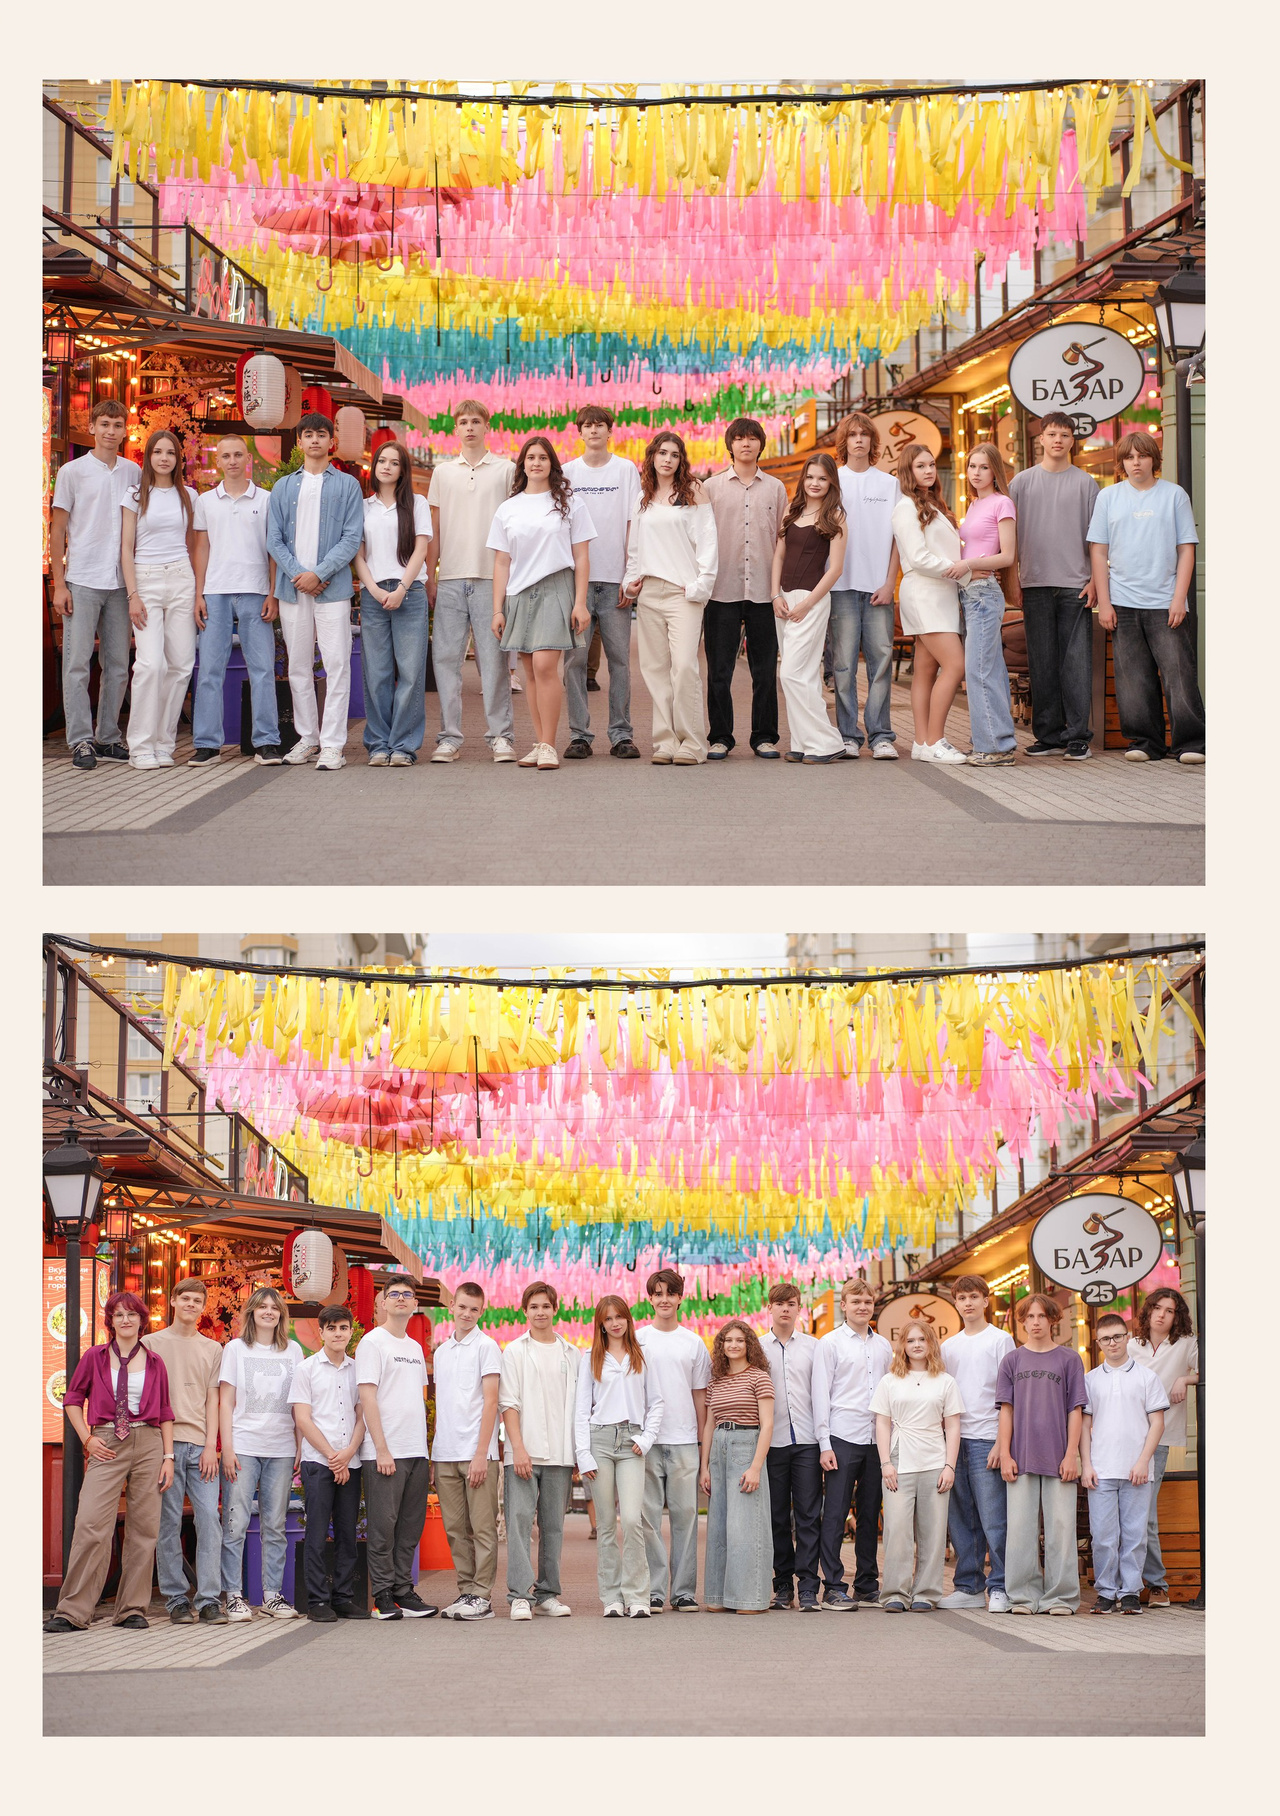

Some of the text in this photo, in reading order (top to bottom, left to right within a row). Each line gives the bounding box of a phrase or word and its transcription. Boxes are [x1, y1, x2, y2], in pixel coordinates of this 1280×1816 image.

[1032, 370, 1123, 406] БАЗАР
[1053, 1240, 1143, 1274] БАЗАР
[1085, 1284, 1114, 1303] 25
[1012, 1369, 1063, 1385] ATEFUL
